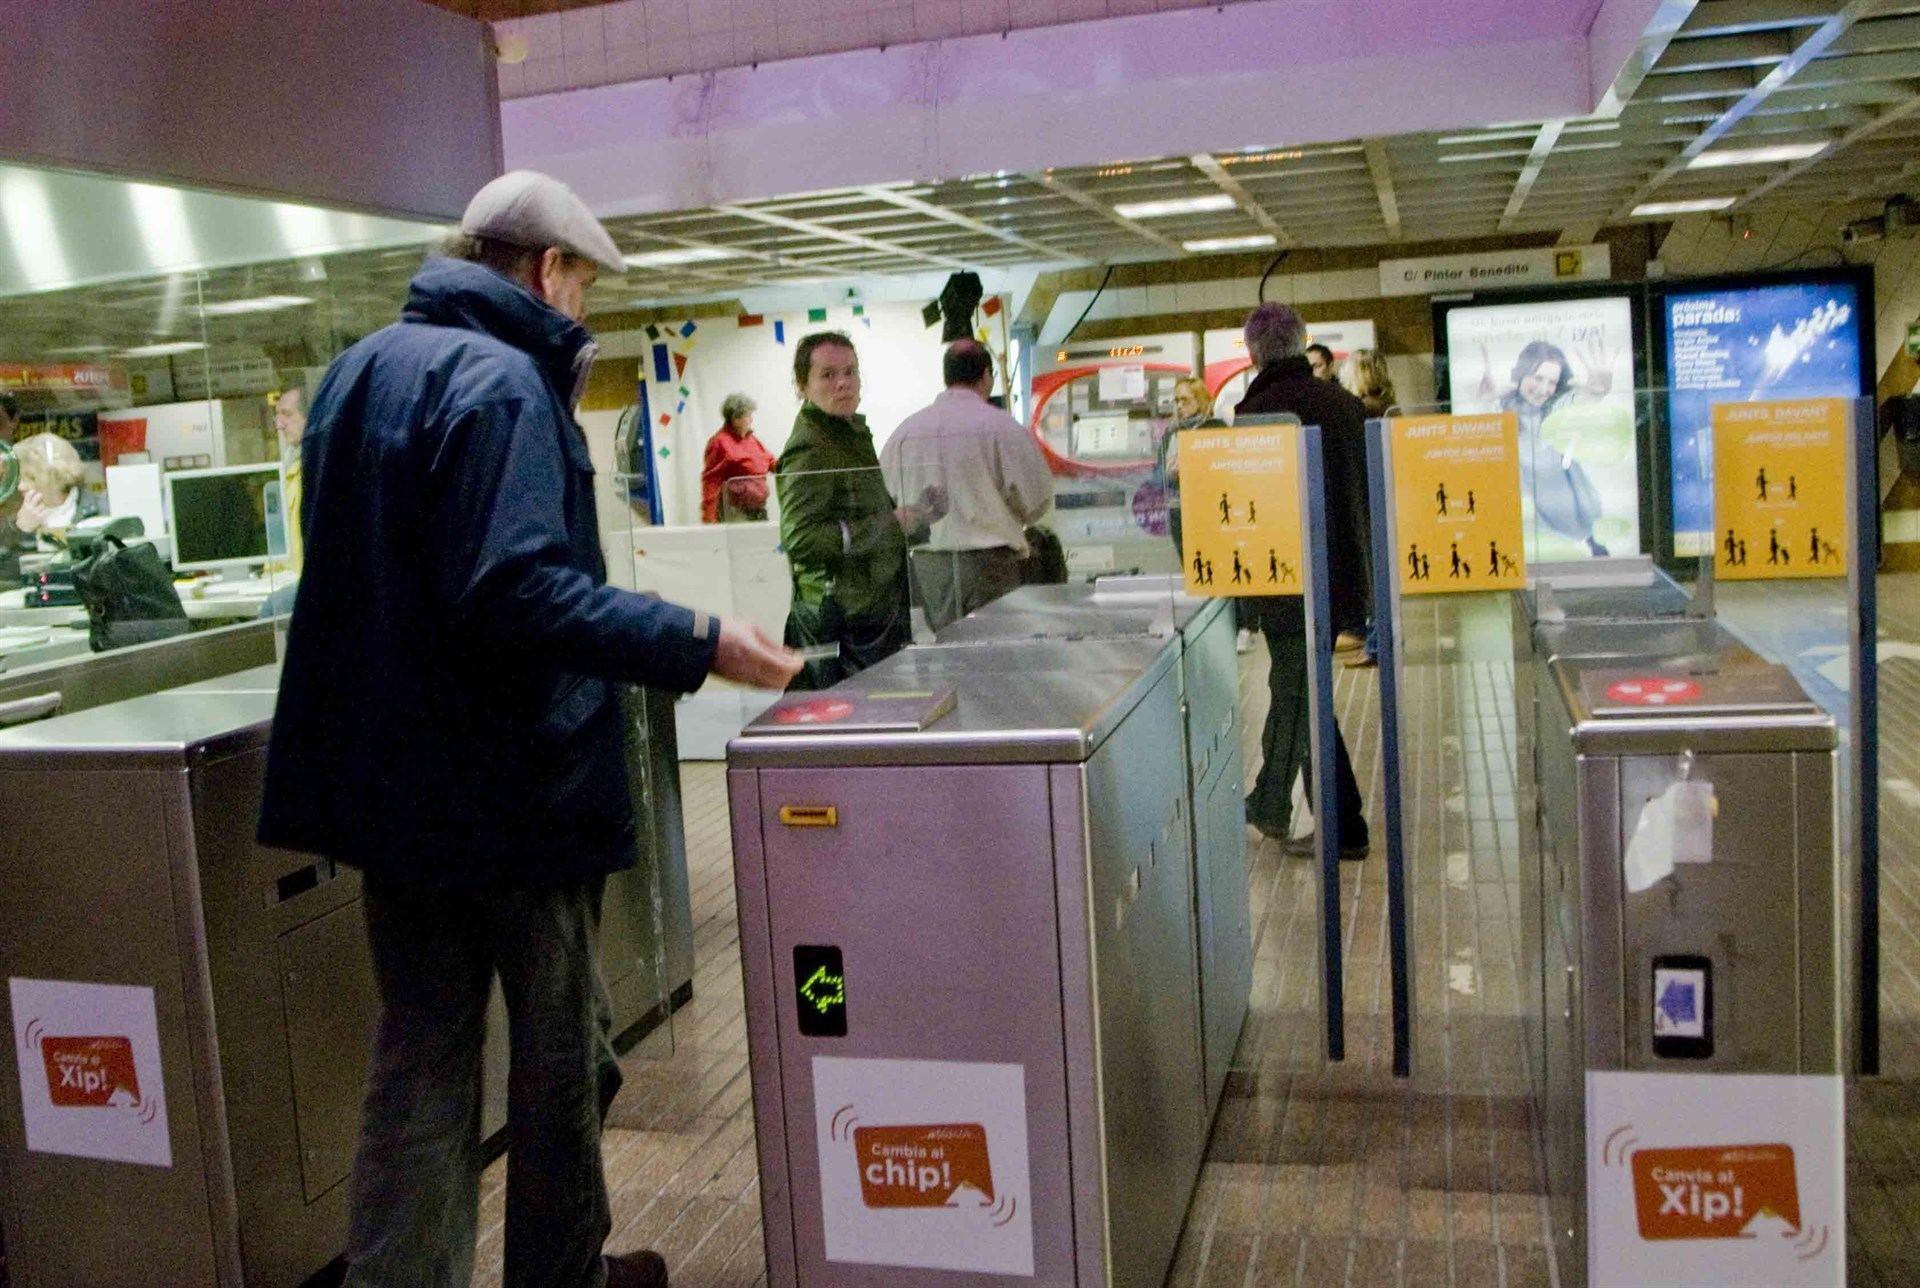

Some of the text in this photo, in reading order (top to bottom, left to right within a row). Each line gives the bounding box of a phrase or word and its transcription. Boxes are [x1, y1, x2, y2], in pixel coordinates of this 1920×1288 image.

[1424, 268, 1463, 282] Pintor
[1469, 263, 1529, 279] Benedito
[1673, 306, 1741, 329] parada:
[1726, 408, 1769, 422] JUNTS
[1775, 406, 1828, 419] DAVANT
[1405, 420, 1504, 438] JUNTS DAVANT
[1190, 433, 1282, 450] JUNTS DAVANT
[59, 1064, 108, 1093] Xip!
[871, 1142, 944, 1160] Cambia al
[865, 1159, 951, 1192] chip!
[1650, 1166, 1735, 1184] Canvia al
[1658, 1183, 1744, 1223] Xip!
